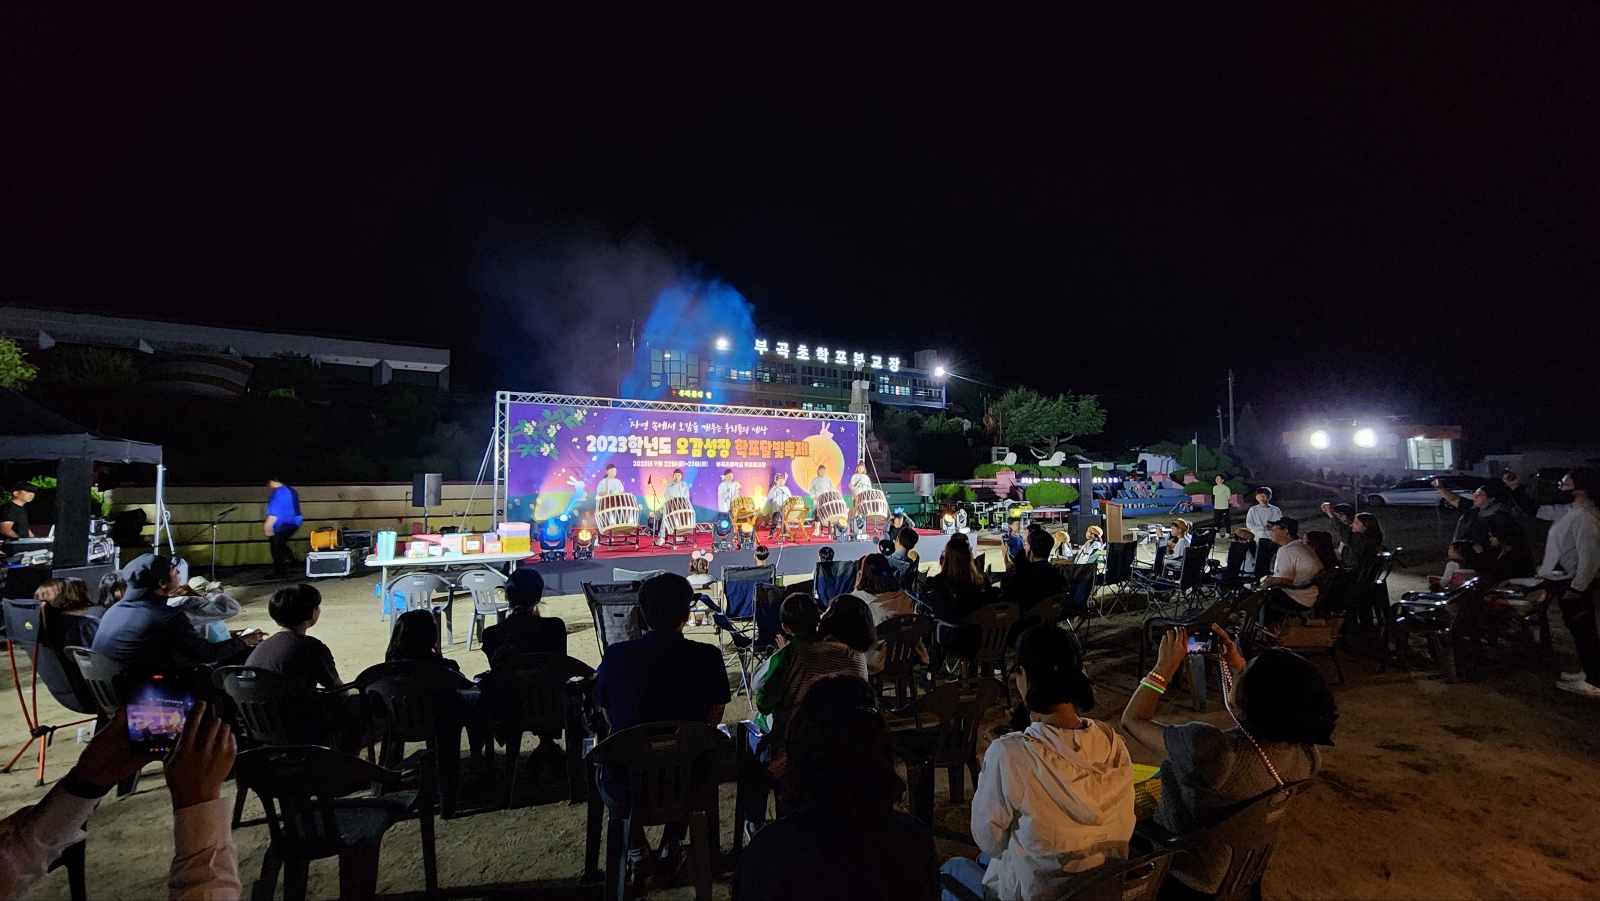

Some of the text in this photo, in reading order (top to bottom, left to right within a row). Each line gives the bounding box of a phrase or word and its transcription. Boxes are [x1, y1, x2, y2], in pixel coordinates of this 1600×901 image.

[629, 419, 649, 430] 자연
[651, 421, 676, 432] 속에서
[678, 421, 699, 433] 오감을
[724, 423, 750, 435] 우리들의
[751, 424, 768, 435] 세상
[586, 434, 809, 460] 2023학년도 오감성장 학포달빛축제
